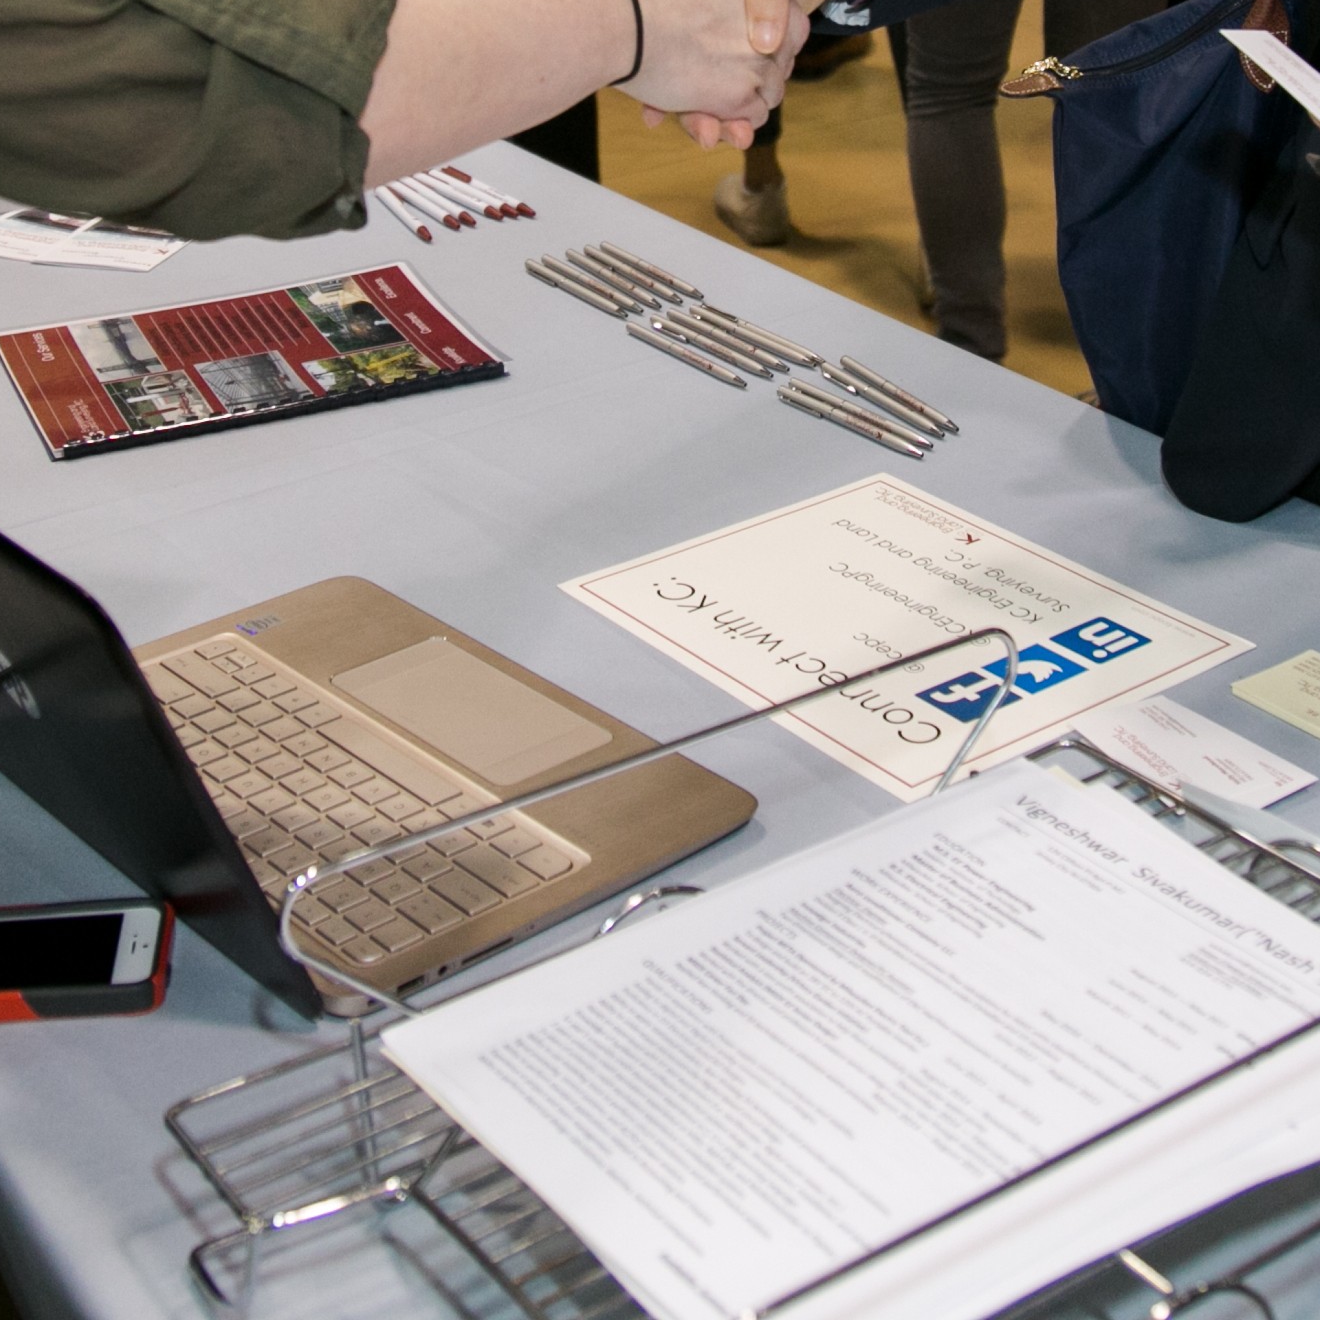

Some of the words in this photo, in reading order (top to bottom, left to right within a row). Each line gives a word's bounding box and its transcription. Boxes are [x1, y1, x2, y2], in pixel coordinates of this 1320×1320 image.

[872, 494, 901, 507] and
[891, 503, 958, 534] Engineering
[828, 517, 882, 542] Land
[871, 538, 918, 560] and
[935, 547, 985, 570] P.C.
[642, 575, 721, 614] KC:
[905, 554, 1020, 610] Engineering
[973, 565, 1076, 614] Surveying,
[699, 608, 792, 655] with
[1005, 605, 1047, 625] KC
[845, 627, 940, 675] @cepc
[1076, 618, 1135, 660] in
[766, 648, 952, 748] Connect
[1123, 744, 1171, 777] Engineering
[1006, 794, 1133, 866] Vigneshwar
[927, 831, 990, 868] EDUCATION
